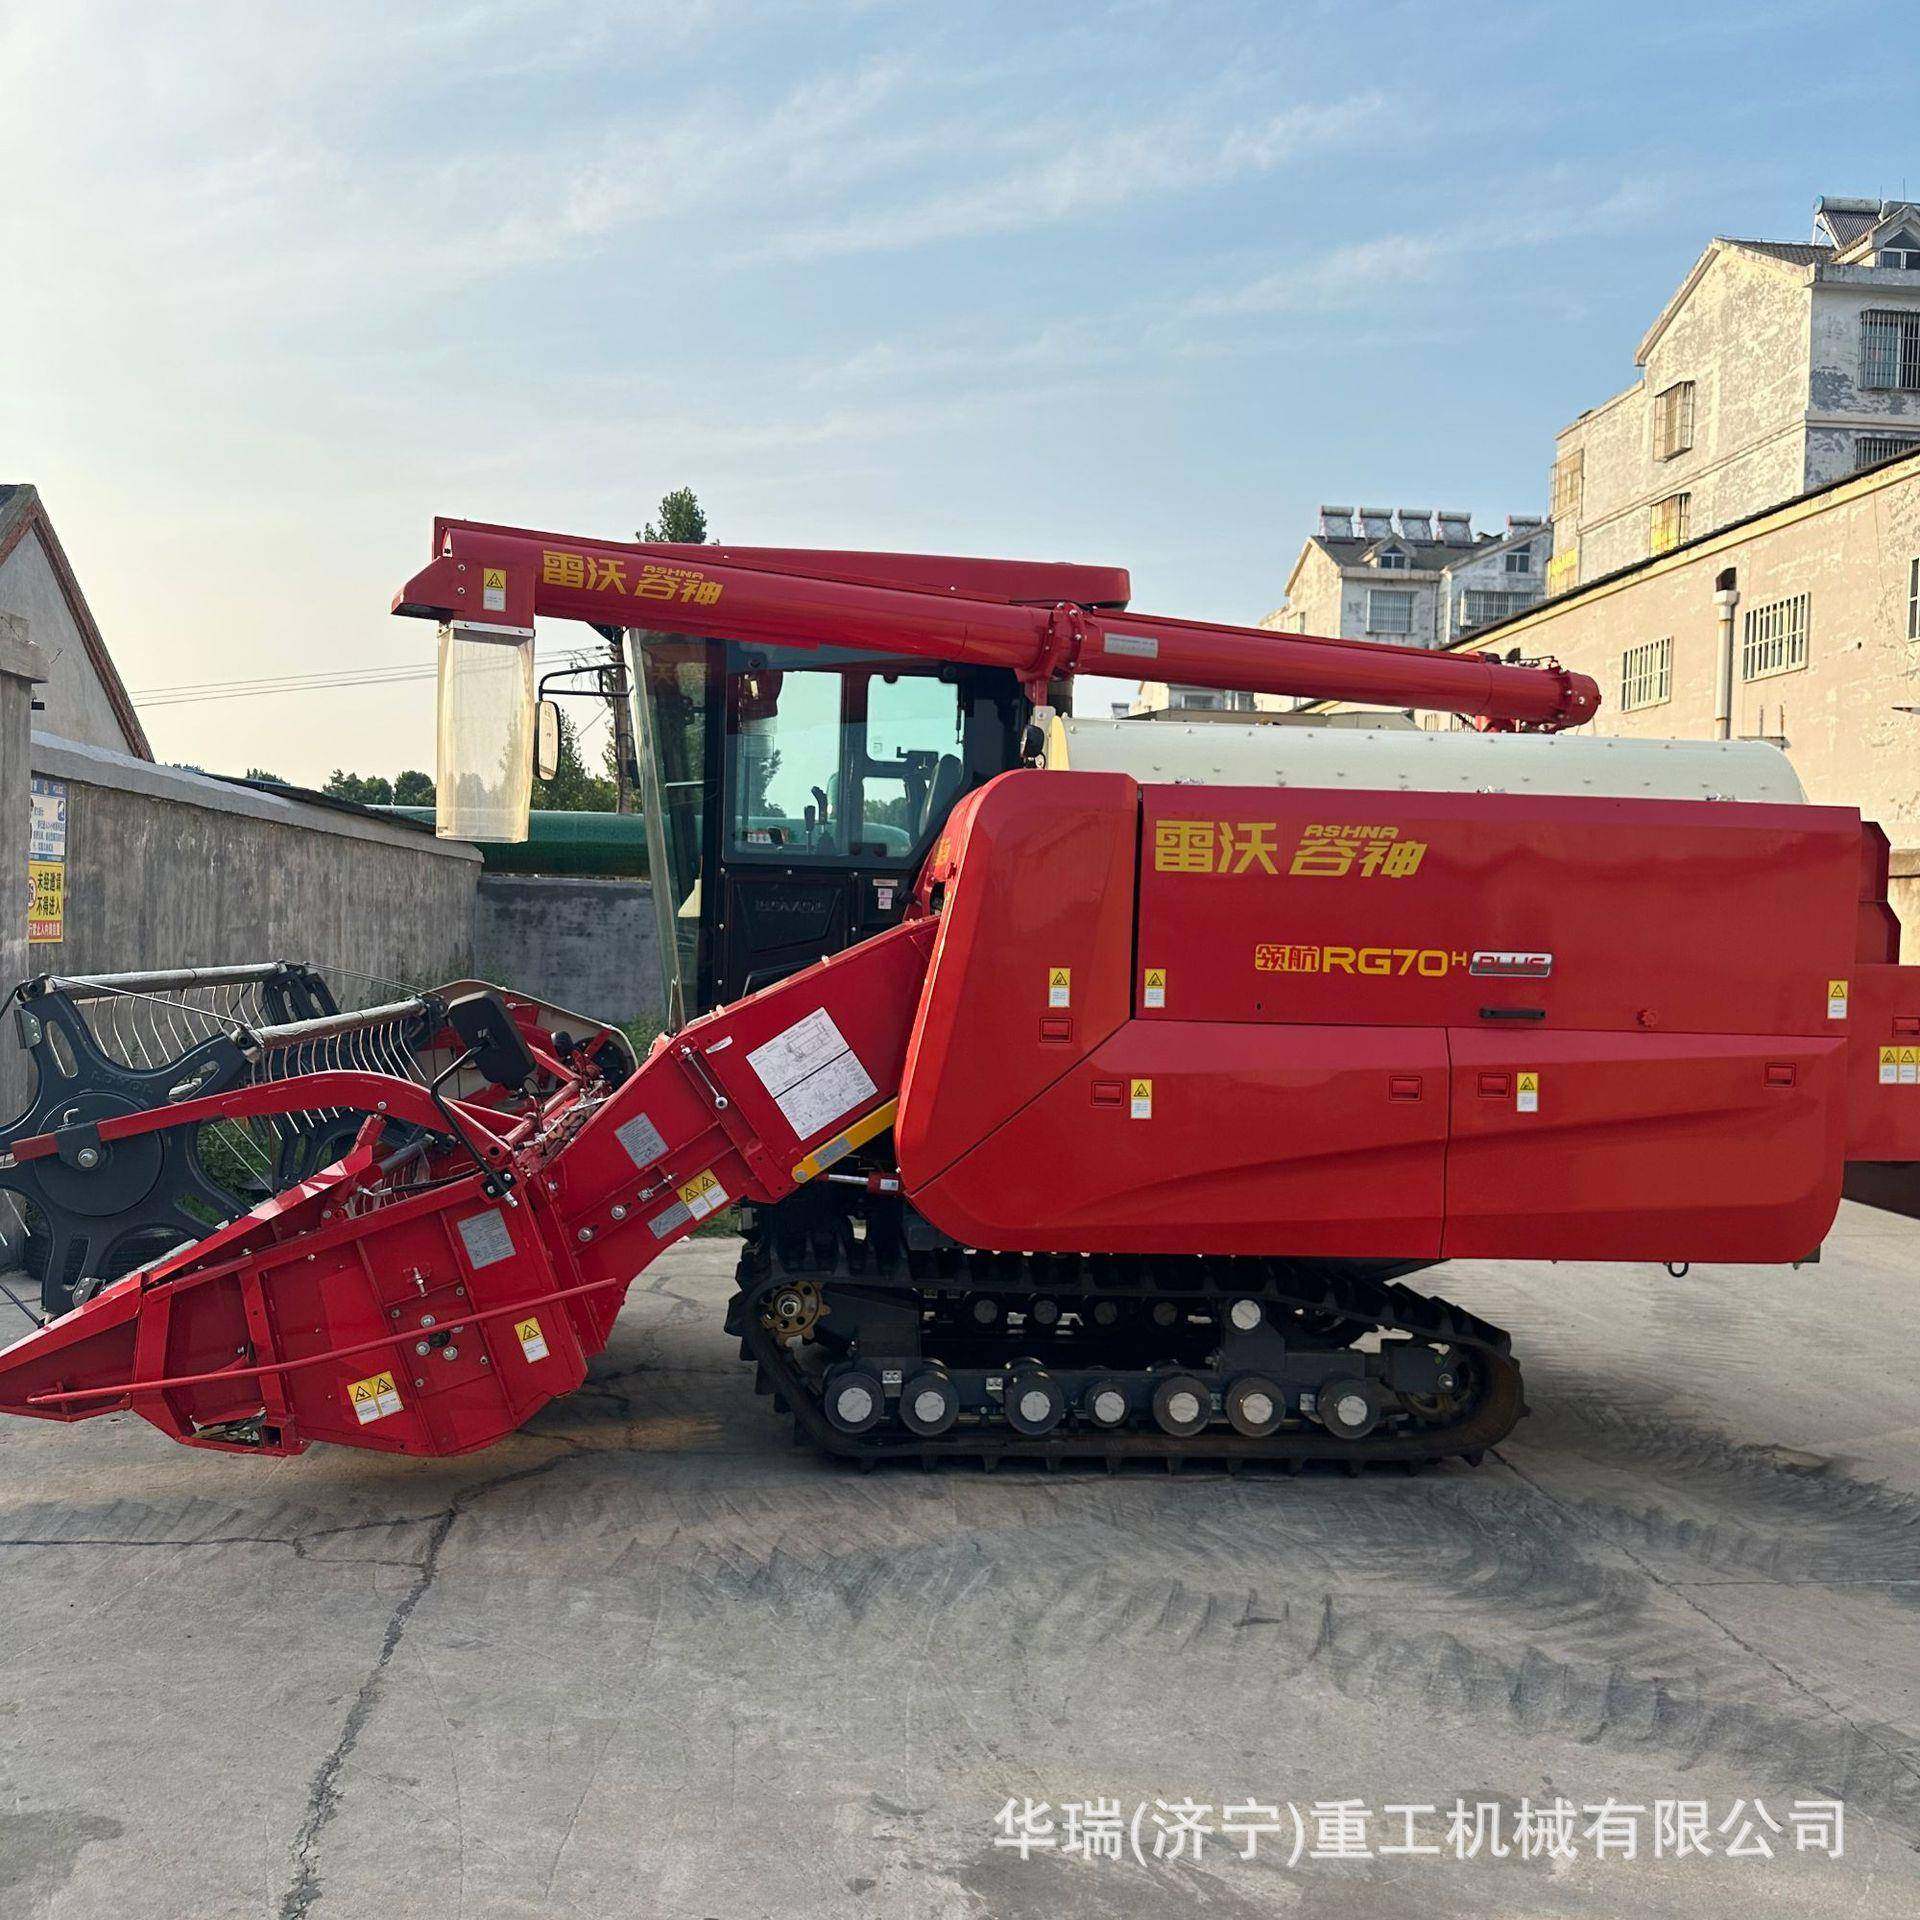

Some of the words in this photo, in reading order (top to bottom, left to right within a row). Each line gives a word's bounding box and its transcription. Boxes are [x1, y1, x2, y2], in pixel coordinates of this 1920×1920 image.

[1304, 824, 1399, 839] ASHNA
[36, 896, 61, 916] 不得进入
